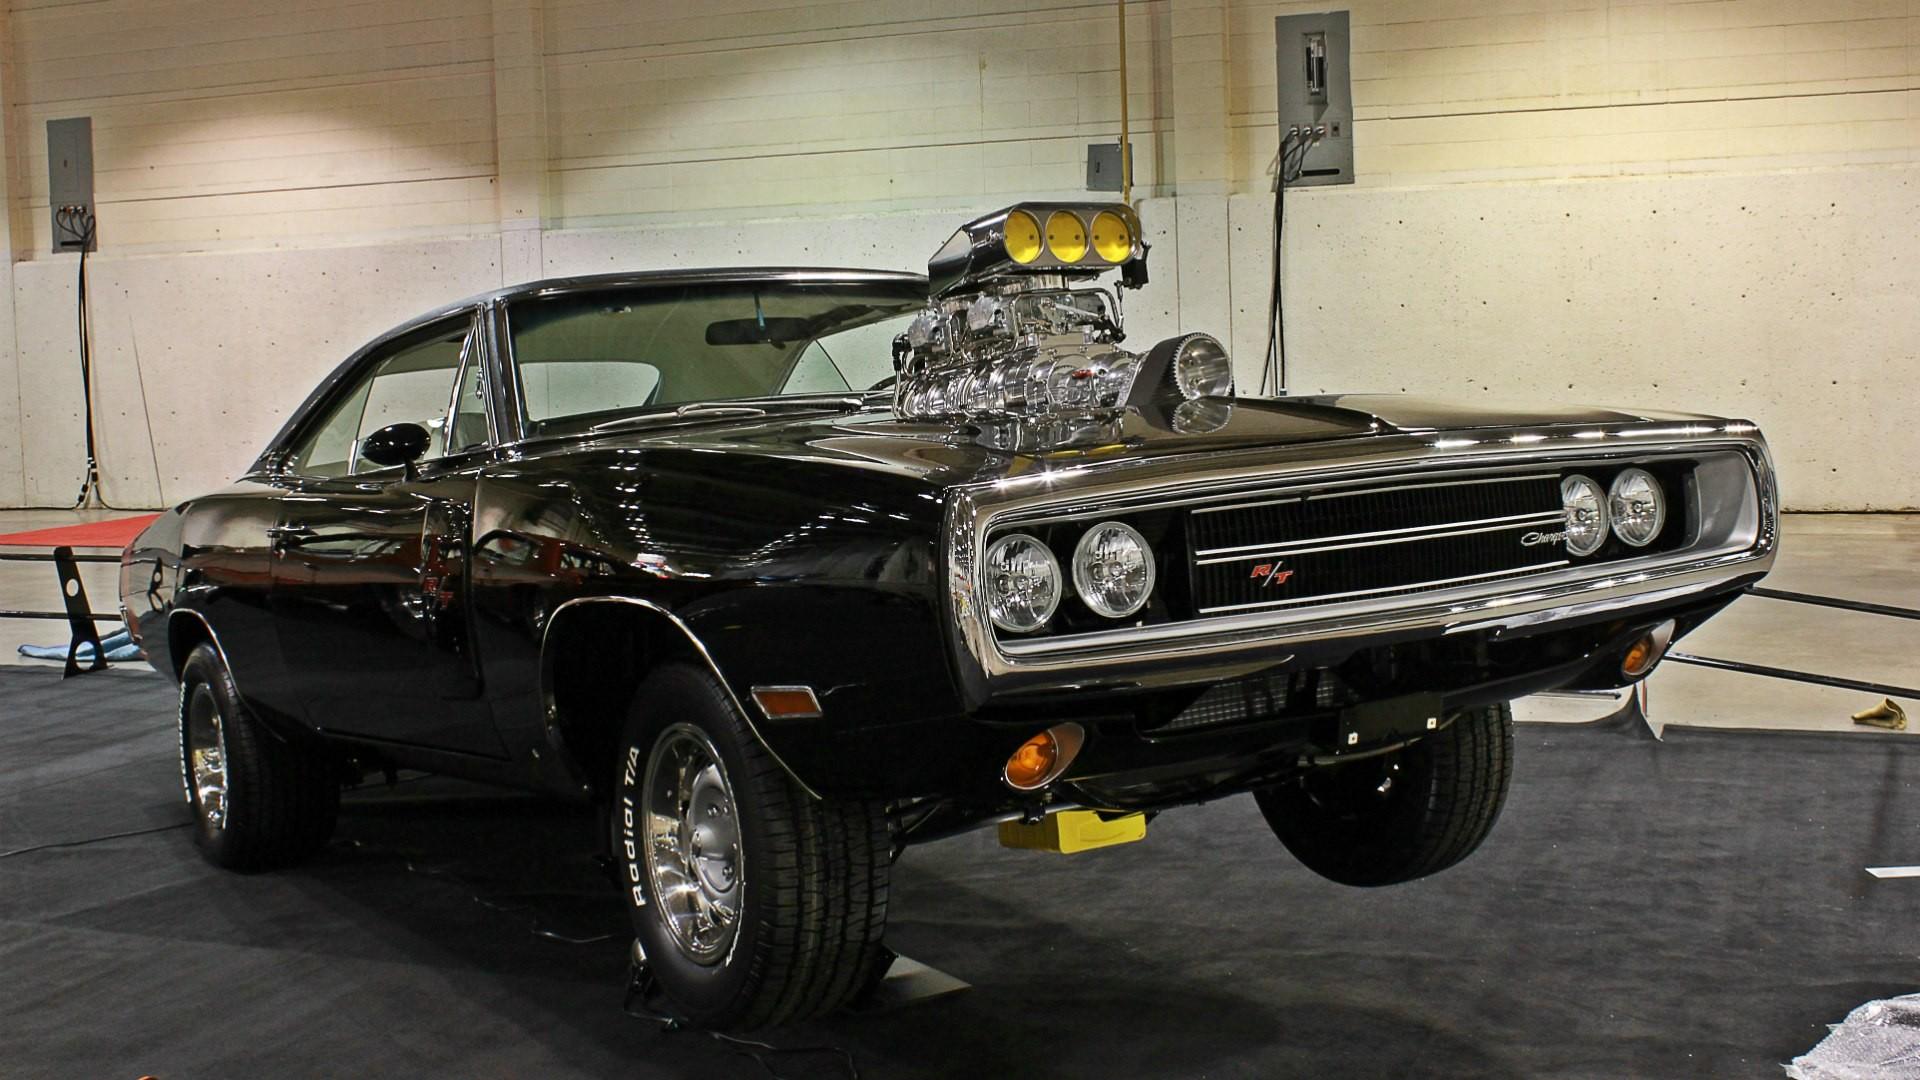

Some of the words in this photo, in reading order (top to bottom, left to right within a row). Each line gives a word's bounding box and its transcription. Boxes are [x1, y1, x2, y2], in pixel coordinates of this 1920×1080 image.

[1250, 561, 1293, 587] R/T
[624, 746, 640, 786] T/A
[623, 797, 647, 907] Radial
